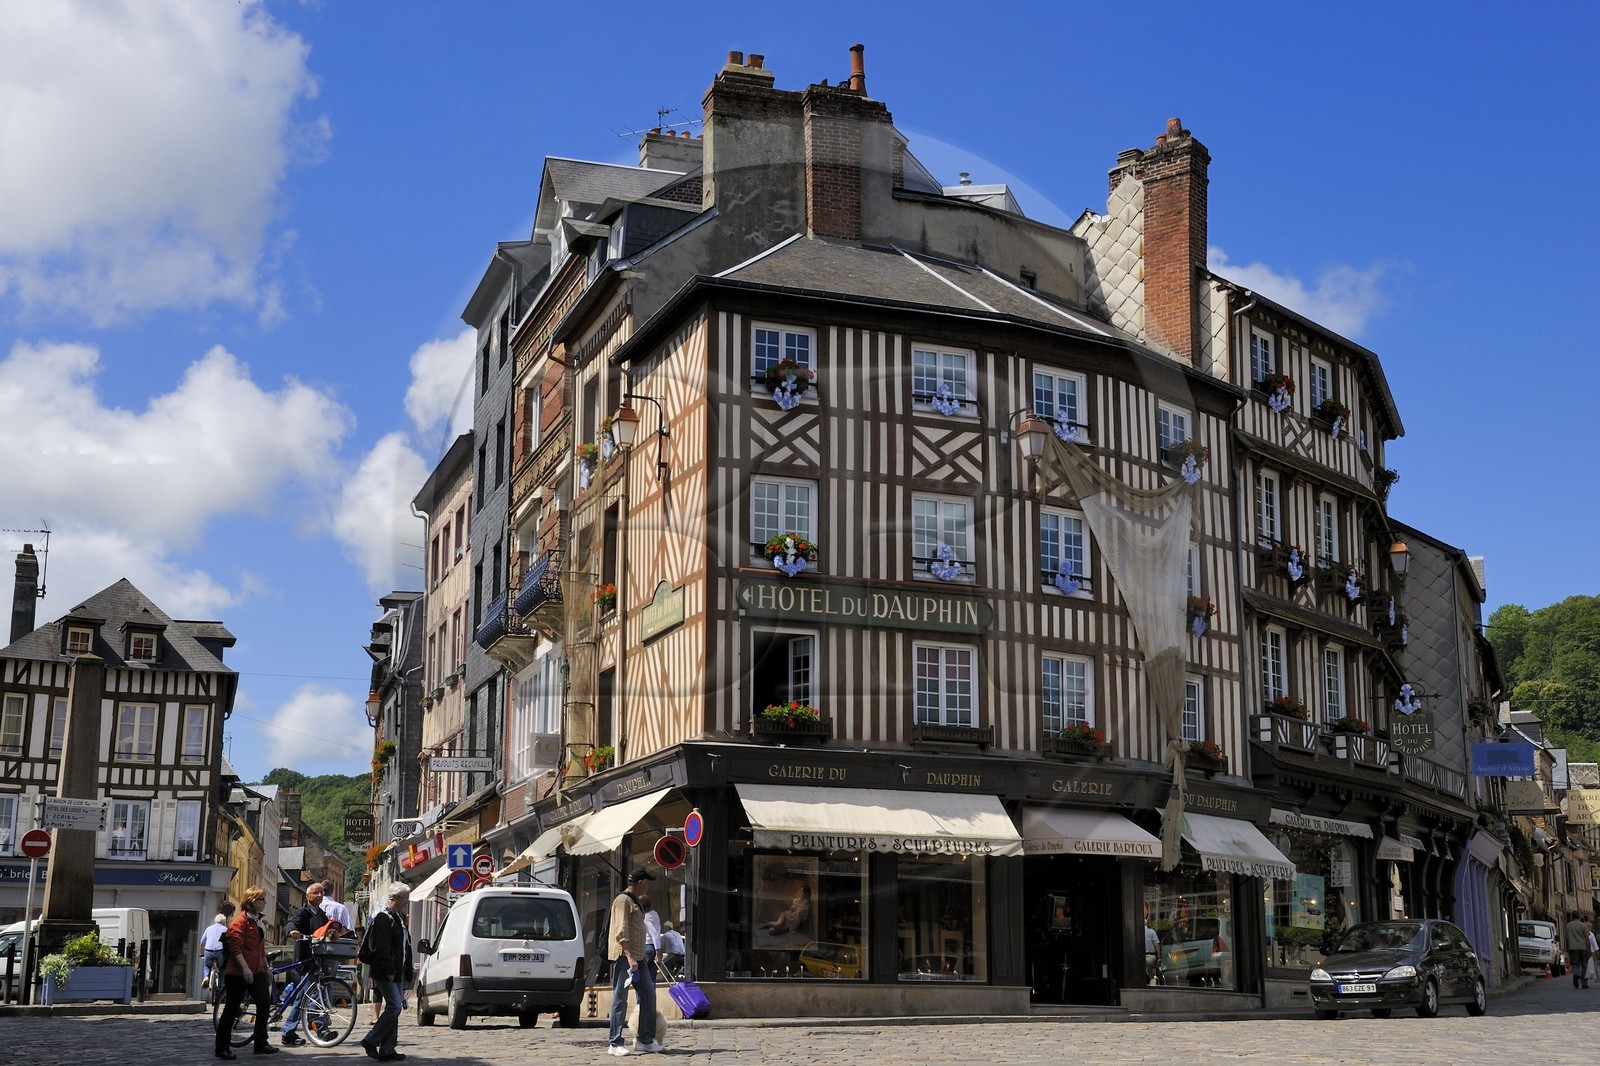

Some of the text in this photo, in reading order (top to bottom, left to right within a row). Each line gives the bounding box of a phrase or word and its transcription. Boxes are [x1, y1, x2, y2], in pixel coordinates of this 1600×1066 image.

[757, 584, 978, 626] HOTEL DU DAUPHIN
[1392, 722, 1433, 735] HOTEL
[1394, 737, 1432, 754] DAUPHIN
[432, 759, 460, 769] PRODUITS
[768, 764, 847, 781] GALERIE DU
[926, 772, 981, 787] DAUPHIN
[1052, 780, 1113, 796] GALERIE
[1196, 795, 1238, 812] DAUPHIN
[346, 818, 373, 827] HOTEL
[1285, 814, 1350, 833] GALERIE DU DAUPHIN
[790, 834, 878, 850] PEINTURES
[892, 838, 993, 853] SCULPTURES
[1074, 841, 1154, 855] GALERIE BARTOUX
